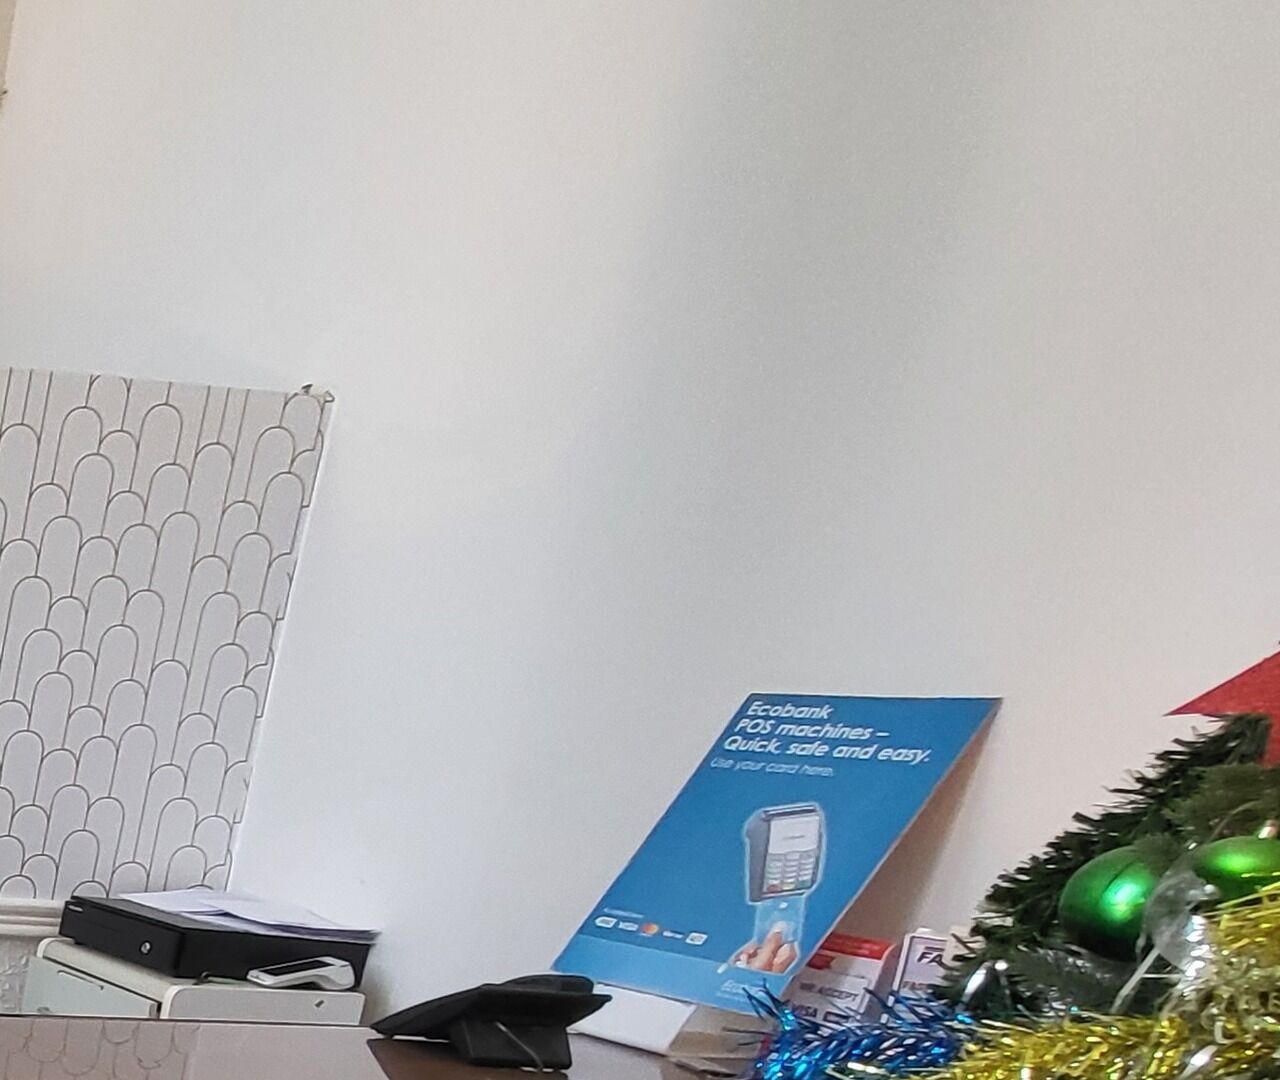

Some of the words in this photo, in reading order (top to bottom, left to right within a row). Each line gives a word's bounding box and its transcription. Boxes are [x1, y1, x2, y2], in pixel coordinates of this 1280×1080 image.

[747, 701, 834, 719] Ecobank
[734, 719, 776, 733] POS
[775, 723, 874, 739] machines
[786, 741, 829, 757] safe
[832, 744, 878, 759] and
[877, 748, 932, 765] easy.
[917, 951, 944, 964] FA
[817, 986, 859, 1002] ACCEPT
